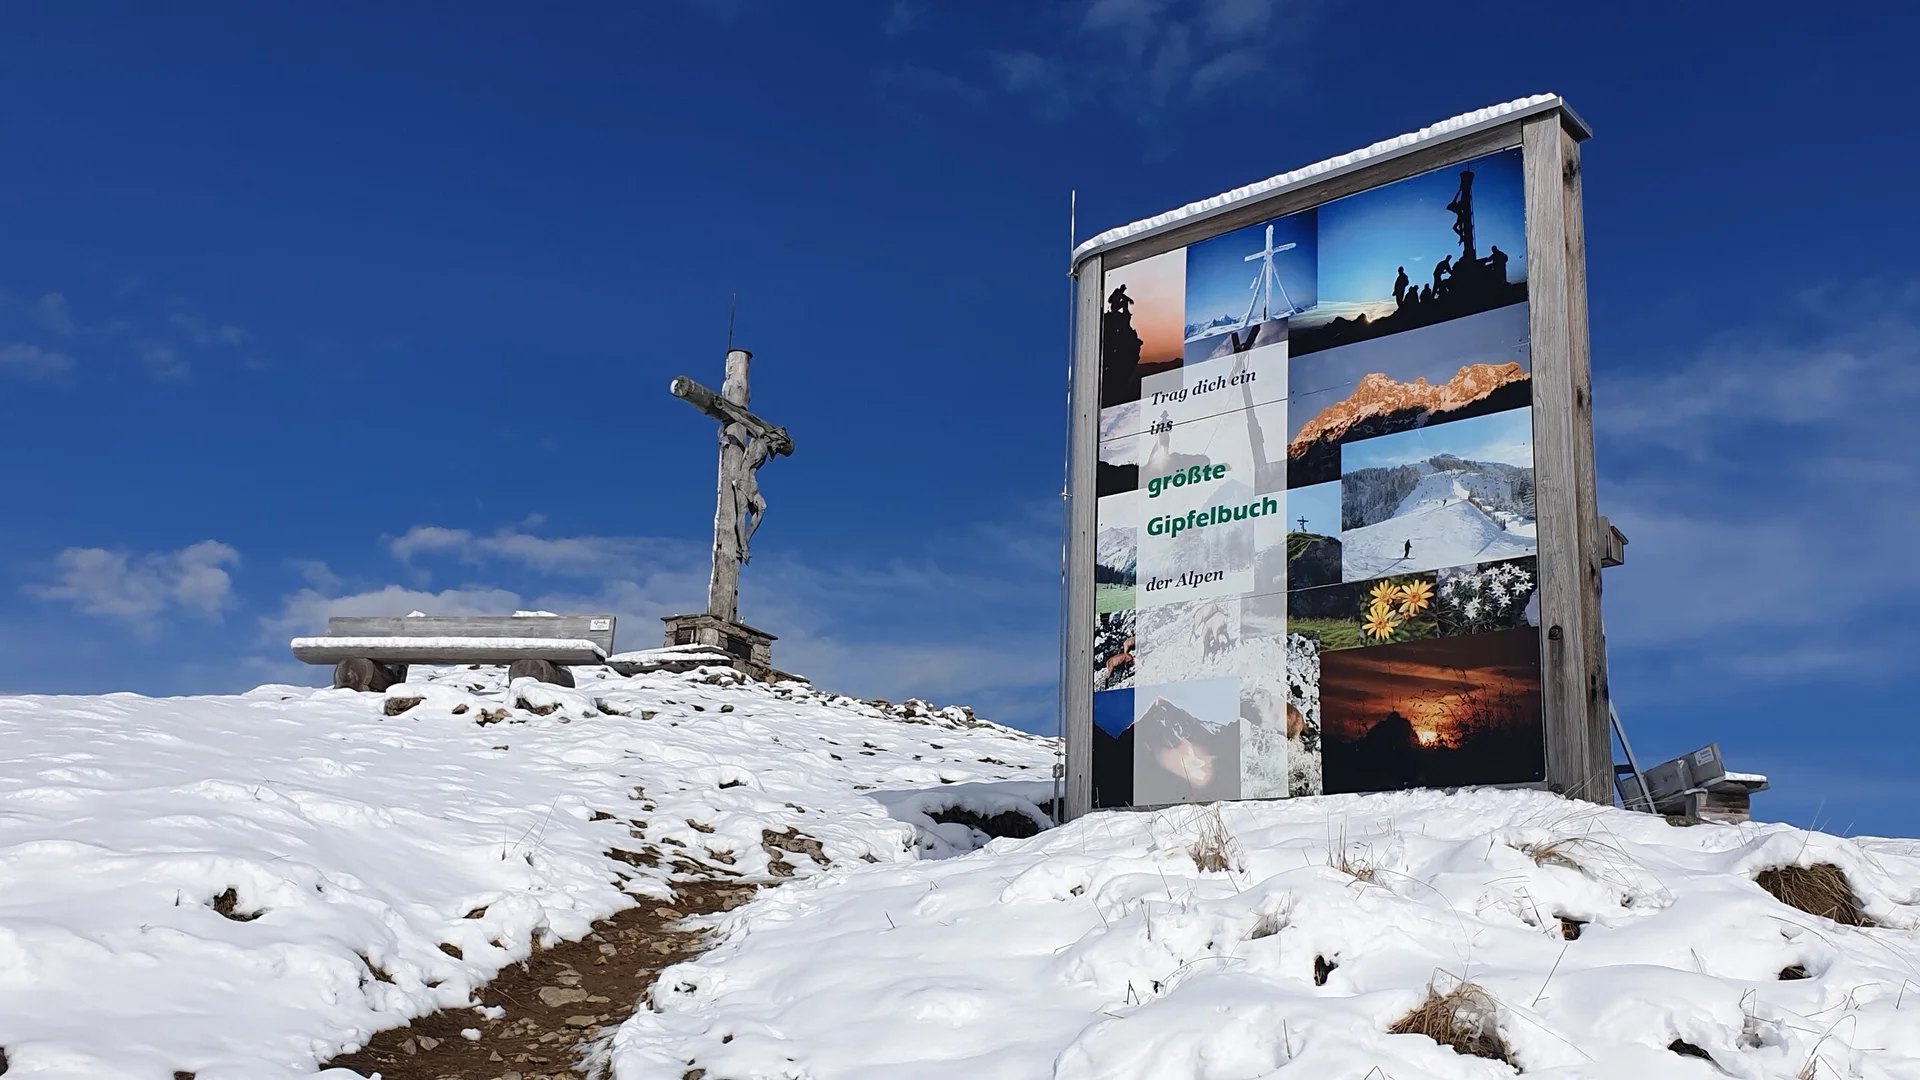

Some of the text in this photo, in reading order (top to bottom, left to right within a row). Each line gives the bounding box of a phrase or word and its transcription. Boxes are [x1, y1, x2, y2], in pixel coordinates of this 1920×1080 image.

[1151, 370, 1256, 405] Trag dich ein
[1150, 419, 1174, 435] ins
[1147, 463, 1226, 498] größte
[1147, 496, 1278, 538] Gipfelbuch
[1146, 570, 1224, 592] der Alpen
